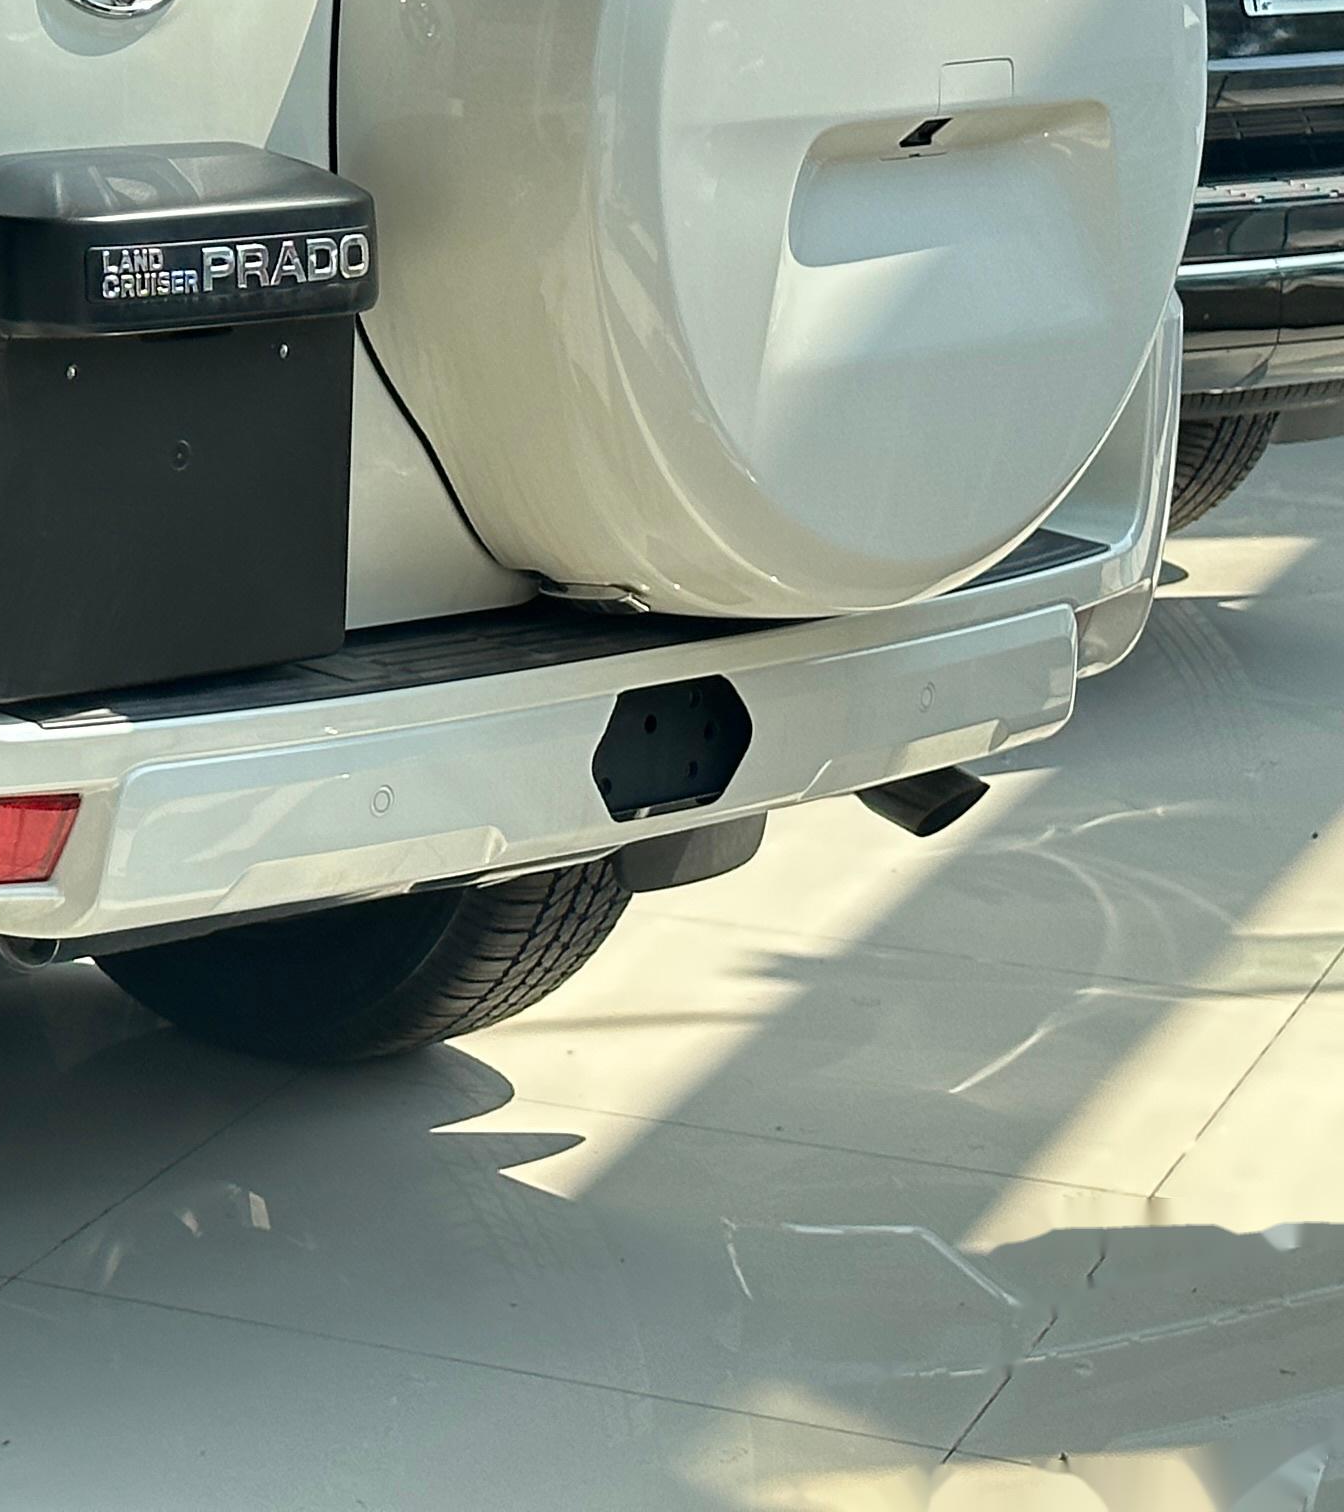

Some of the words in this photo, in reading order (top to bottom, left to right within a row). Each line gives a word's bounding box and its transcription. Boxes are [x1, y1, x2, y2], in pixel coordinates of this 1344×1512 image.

[102, 247, 162, 274] LAND
[201, 233, 370, 292] PRADO
[101, 269, 199, 300] CRUISER
